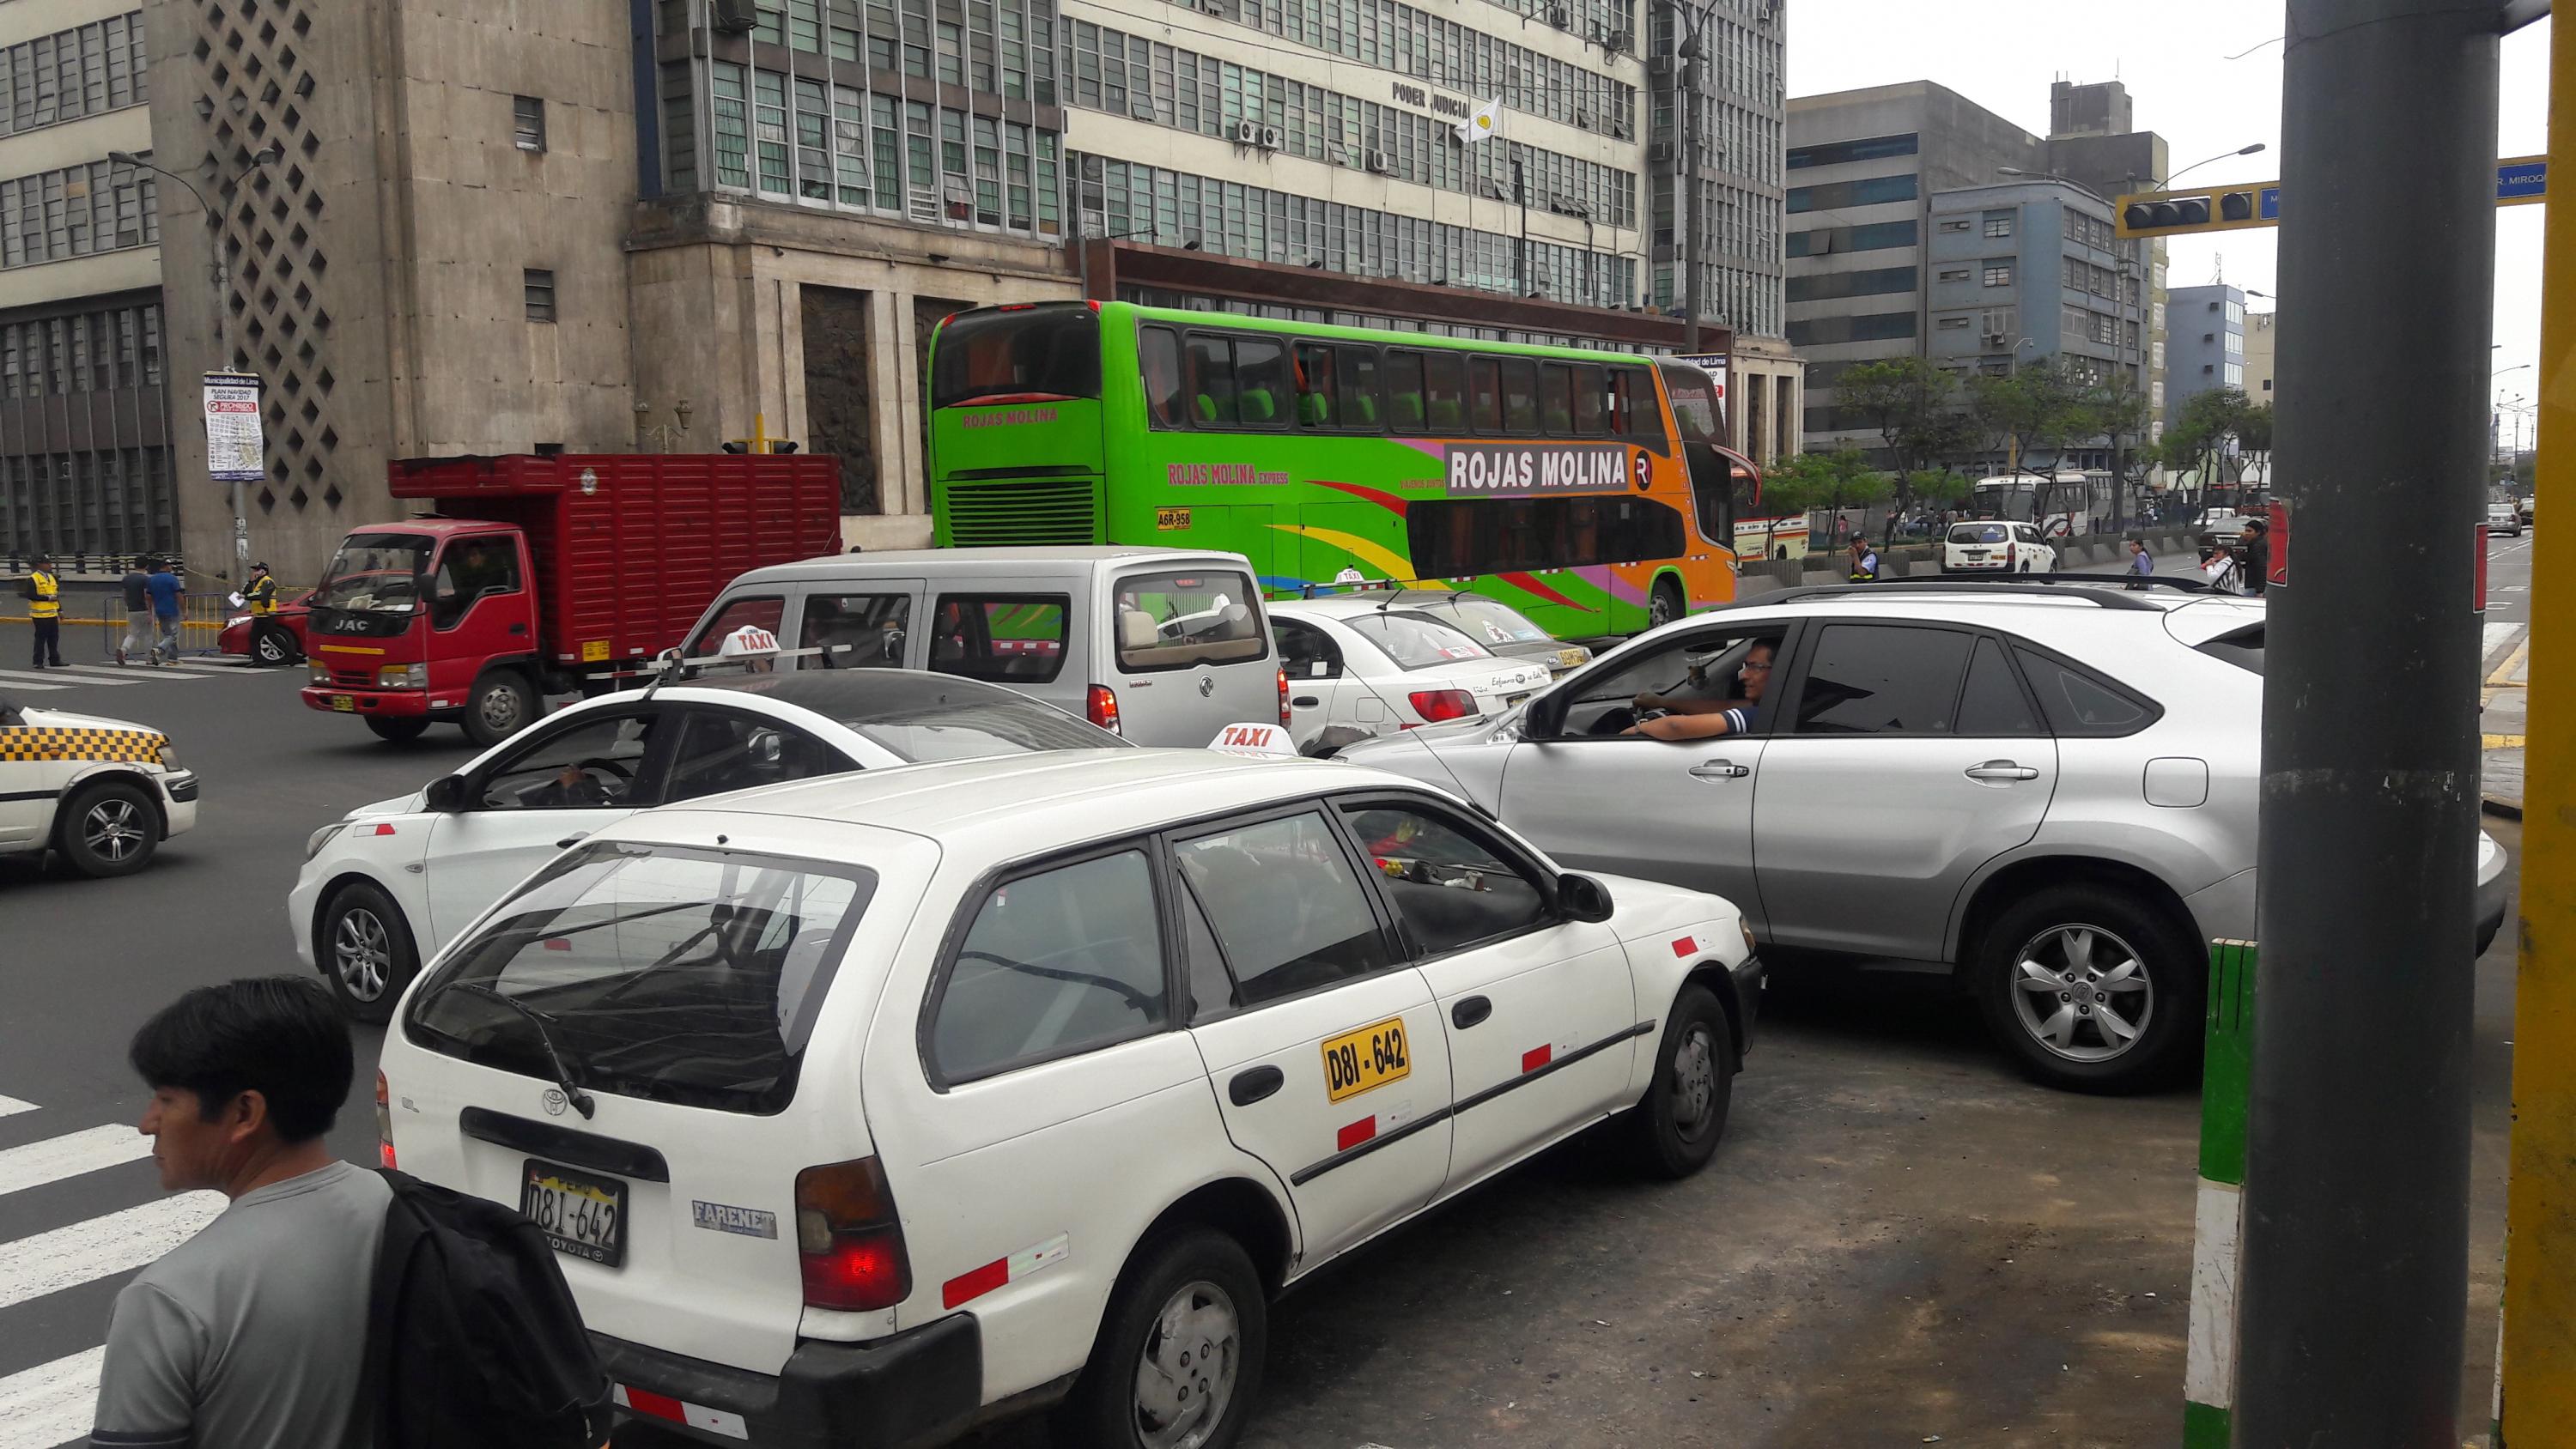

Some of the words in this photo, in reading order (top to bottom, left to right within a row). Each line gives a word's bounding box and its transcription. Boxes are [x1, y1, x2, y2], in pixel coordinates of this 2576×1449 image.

[1392, 82, 1425, 108] PODER
[963, 413, 1004, 428] ROJAS
[1005, 408, 1058, 425] MOLINA
[1168, 464, 1208, 485] ROJAS
[1211, 464, 1255, 484] MOLINA
[1258, 472, 1289, 485] EXPRESS
[1449, 451, 1534, 488] ROJAS
[1540, 451, 1626, 487] MOLINA
[1158, 513, 1190, 526] A6R-958
[1344, 572, 1360, 580] TAXI
[336, 619, 369, 631] JAC
[738, 634, 774, 651] TAXI
[1224, 727, 1273, 747] TAXI
[693, 1202, 775, 1231] FARENET
